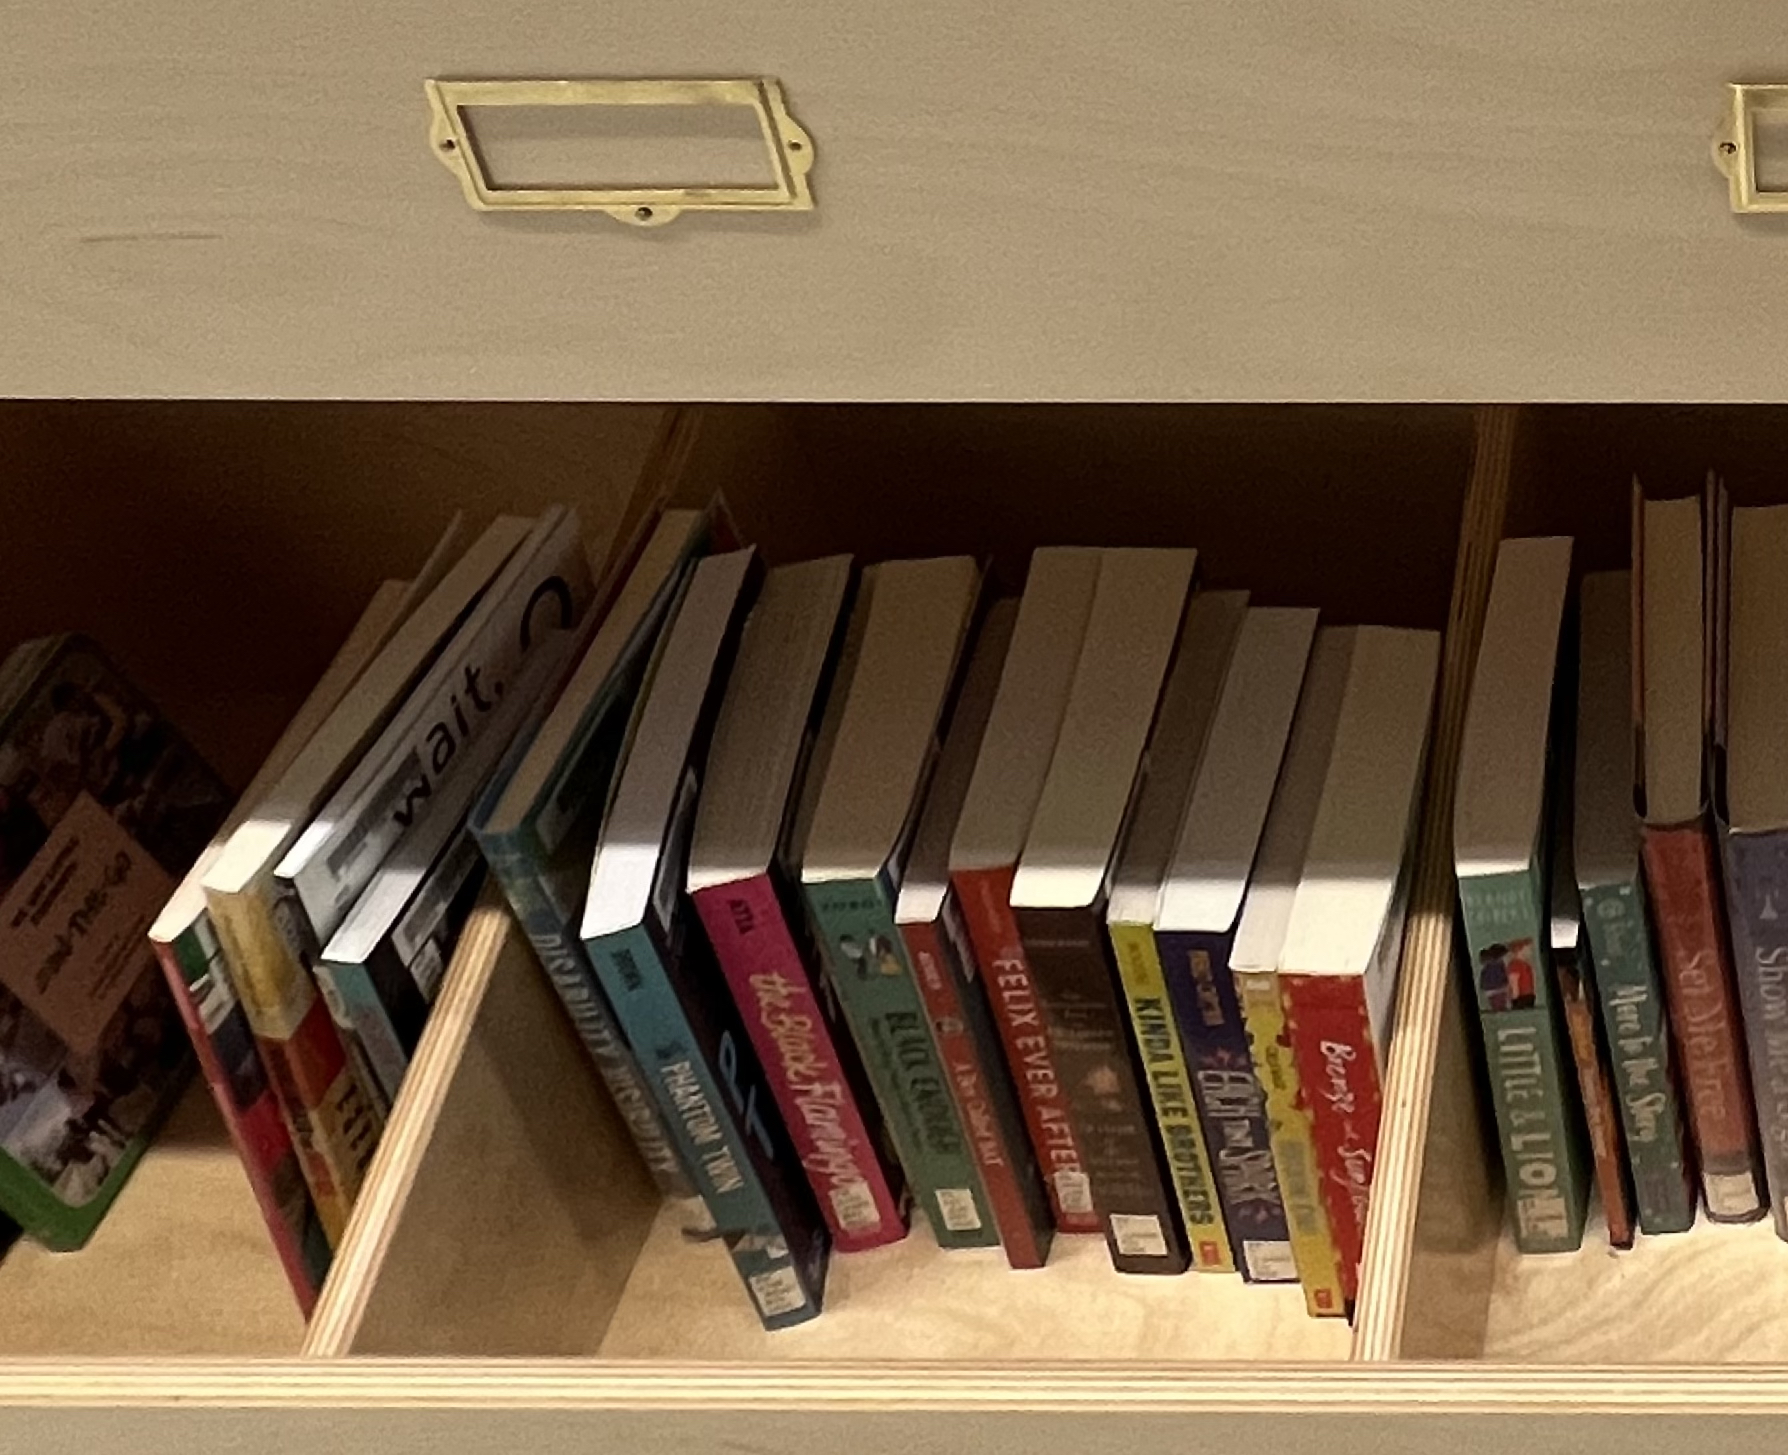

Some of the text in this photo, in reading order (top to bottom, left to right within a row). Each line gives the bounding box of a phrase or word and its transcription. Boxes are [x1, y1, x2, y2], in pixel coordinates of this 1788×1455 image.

[993, 957, 1040, 1028] FELIX
[1018, 1035, 1058, 1102] EVER
[1497, 1025, 1543, 1104] LITTLE
